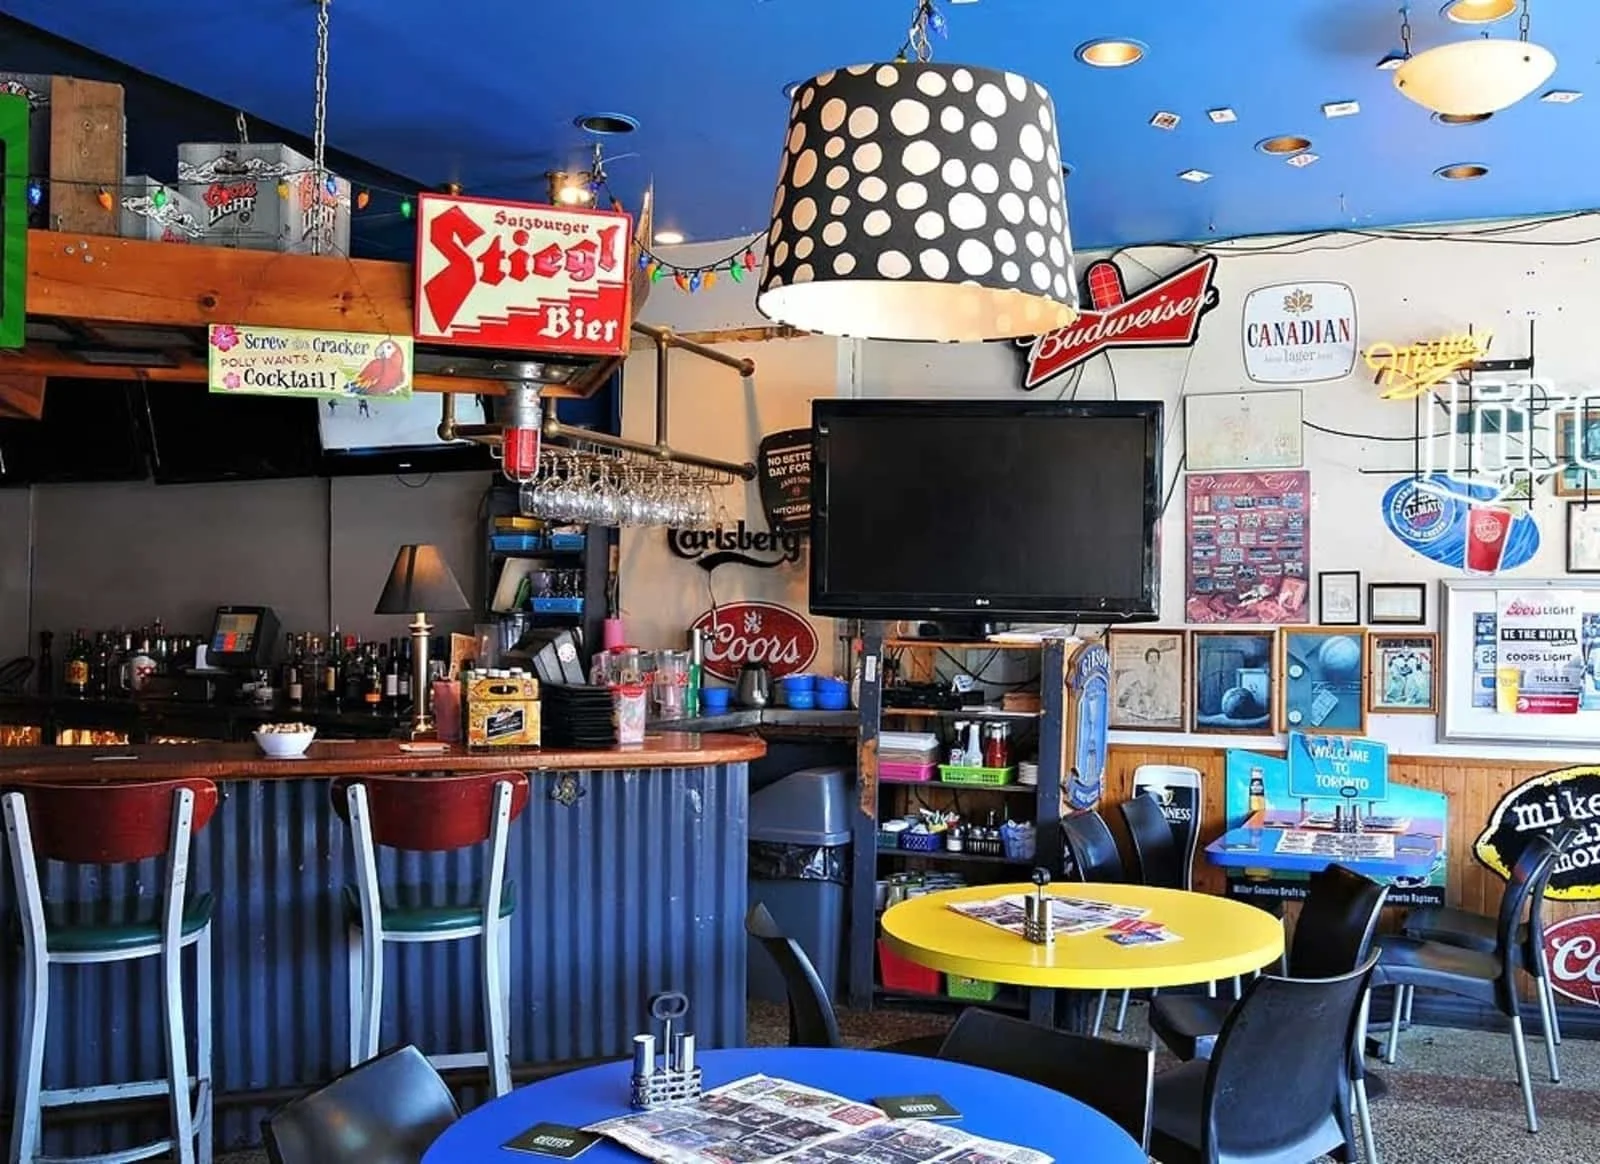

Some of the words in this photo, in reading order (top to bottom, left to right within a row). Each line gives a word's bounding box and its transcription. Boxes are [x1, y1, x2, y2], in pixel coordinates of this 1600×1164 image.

[209, 197, 256, 224] LIGHT
[424, 205, 620, 333] Stiegl
[537, 305, 619, 343] Bier
[1016, 290, 1215, 361] Budweiser
[1247, 317, 1350, 348] CANADIAN
[244, 333, 289, 350] Screw
[312, 337, 371, 356] Cracker
[221, 356, 257, 369] POLLY
[261, 354, 310, 366] WANTS
[314, 354, 325, 364] A
[1284, 349, 1316, 363] lager
[243, 367, 338, 390] Cocktail!
[767, 456, 782, 467] NO
[782, 451, 812, 463] BETTE
[768, 465, 788, 478] DAY
[789, 462, 811, 474] FOR
[667, 520, 800, 563] Carlsberg
[1543, 605, 1576, 616] LIGHT
[703, 623, 799, 664] Coors
[1519, 631, 1538, 640] THE
[1506, 653, 1541, 662] COORS
[1543, 653, 1573, 662] LIGHT
[1535, 674, 1570, 683] TICKETS
[1312, 744, 1370, 763] WELCOME
[1334, 762, 1350, 775] TO
[1316, 774, 1369, 790] TORONTO
